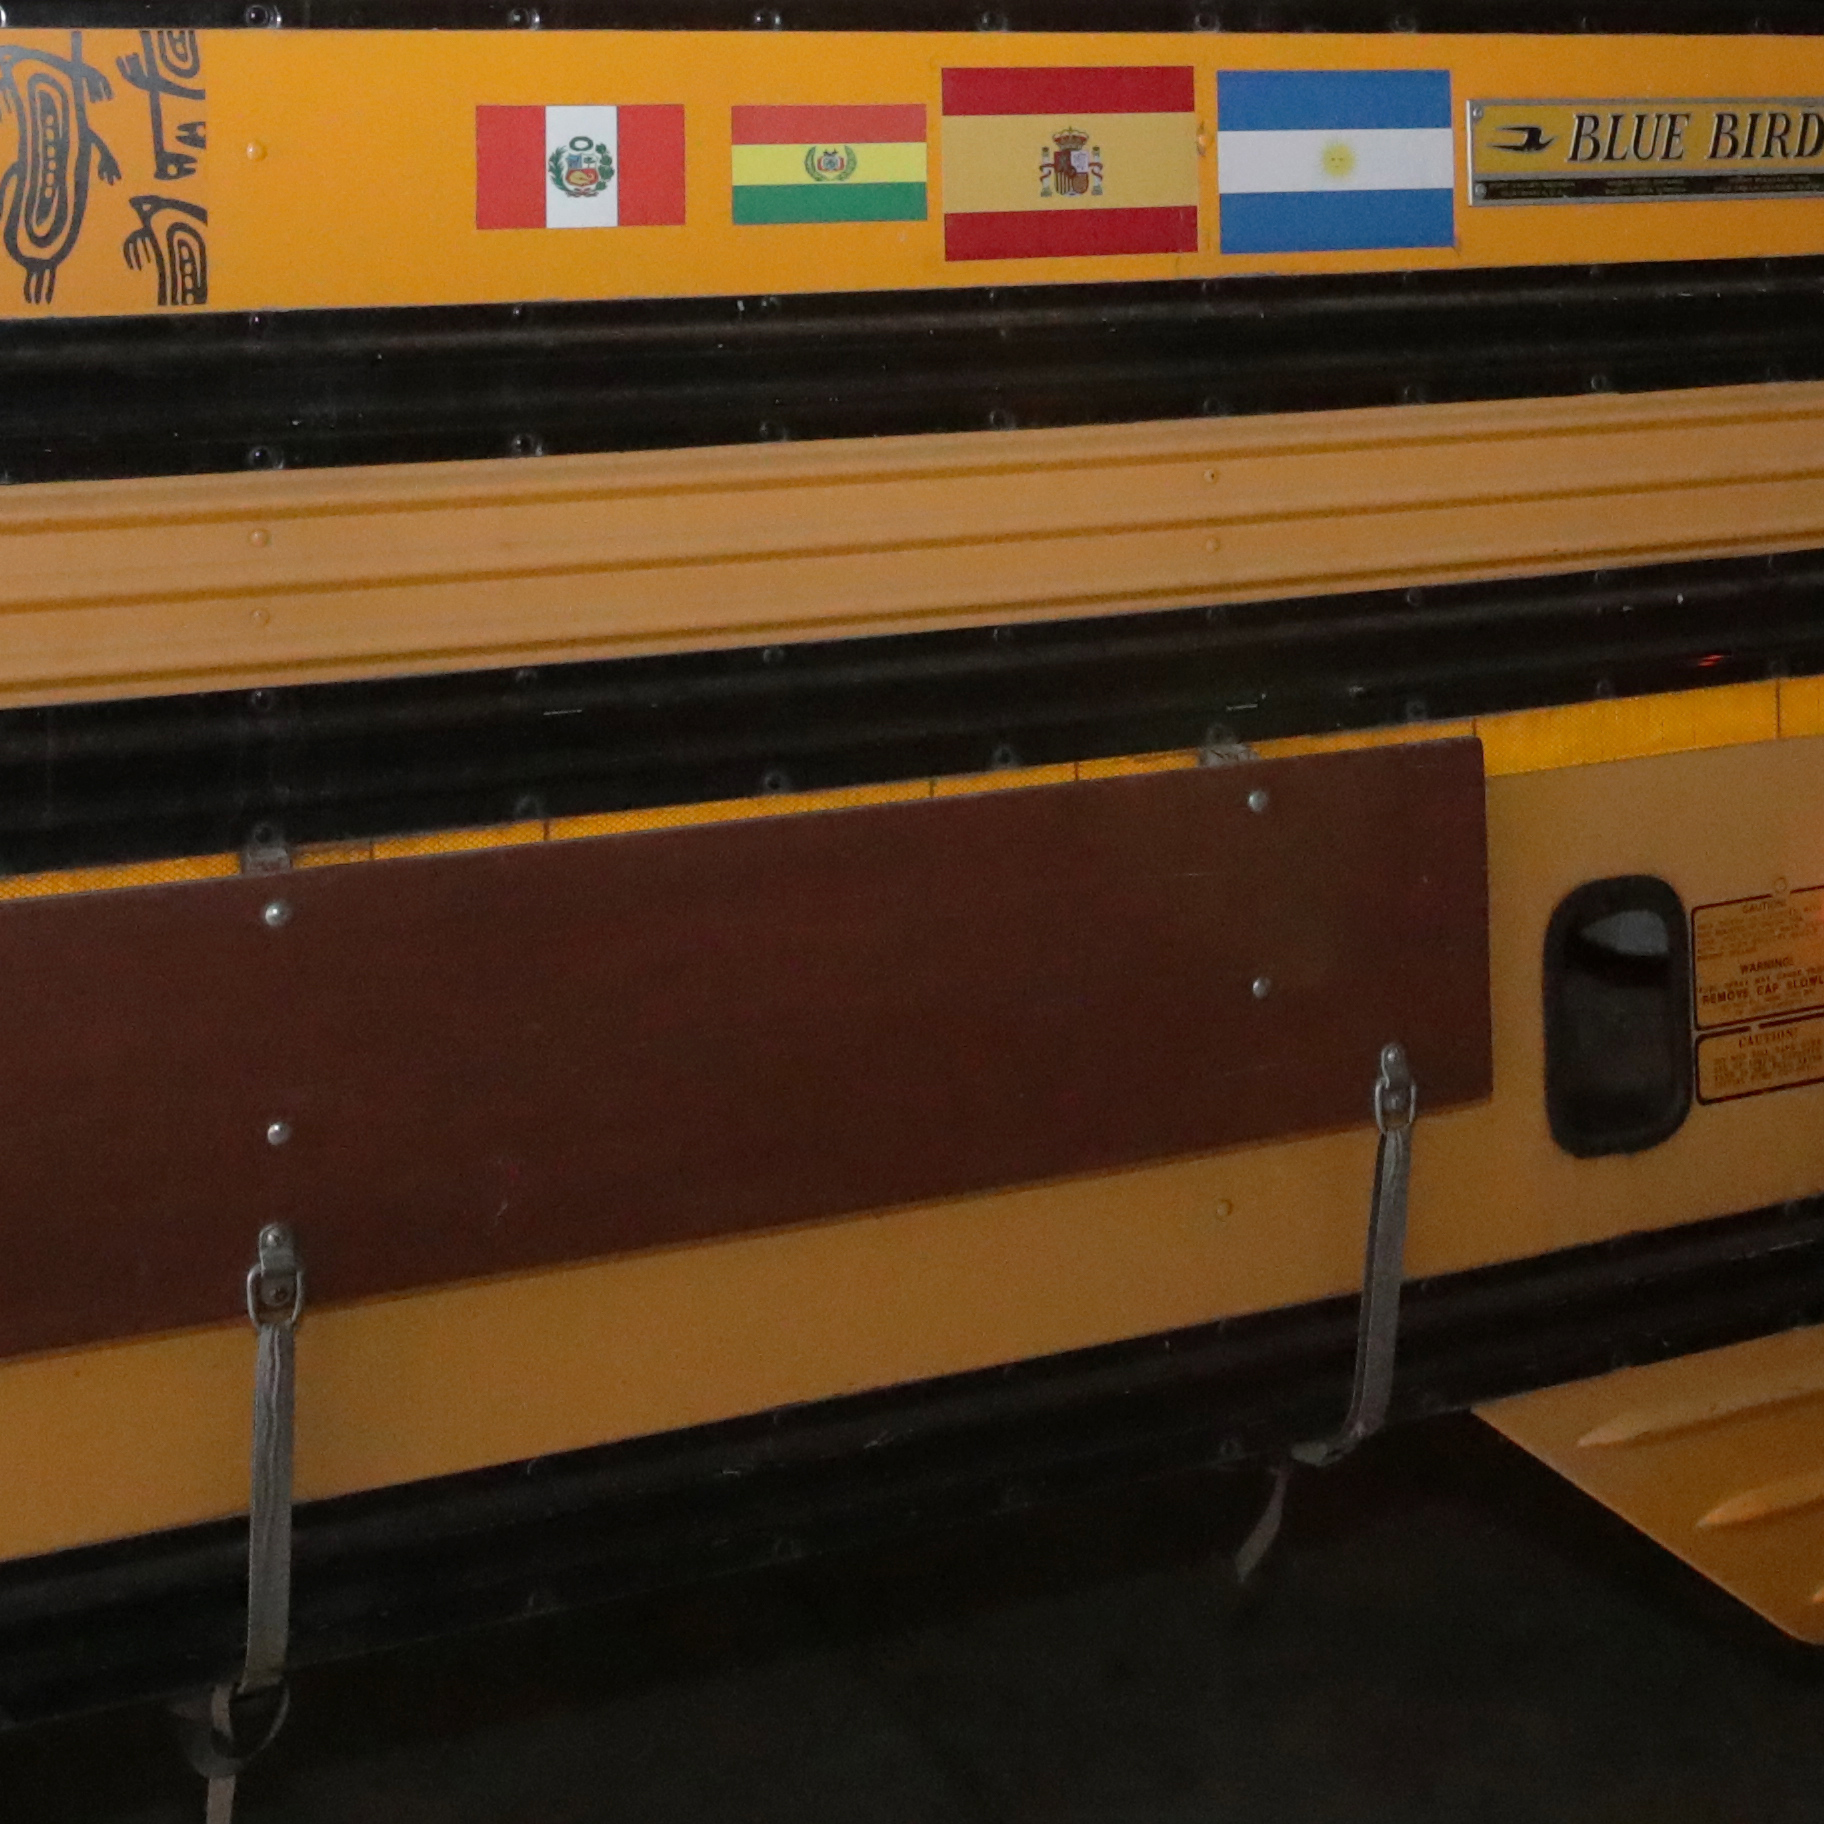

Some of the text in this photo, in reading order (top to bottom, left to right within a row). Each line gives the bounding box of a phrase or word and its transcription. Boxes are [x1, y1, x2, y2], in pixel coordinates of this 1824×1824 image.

[1565, 112, 1691, 163] BLUE
[1701, 988, 1749, 1005] REMOVE
[1756, 982, 1780, 996] CAP
